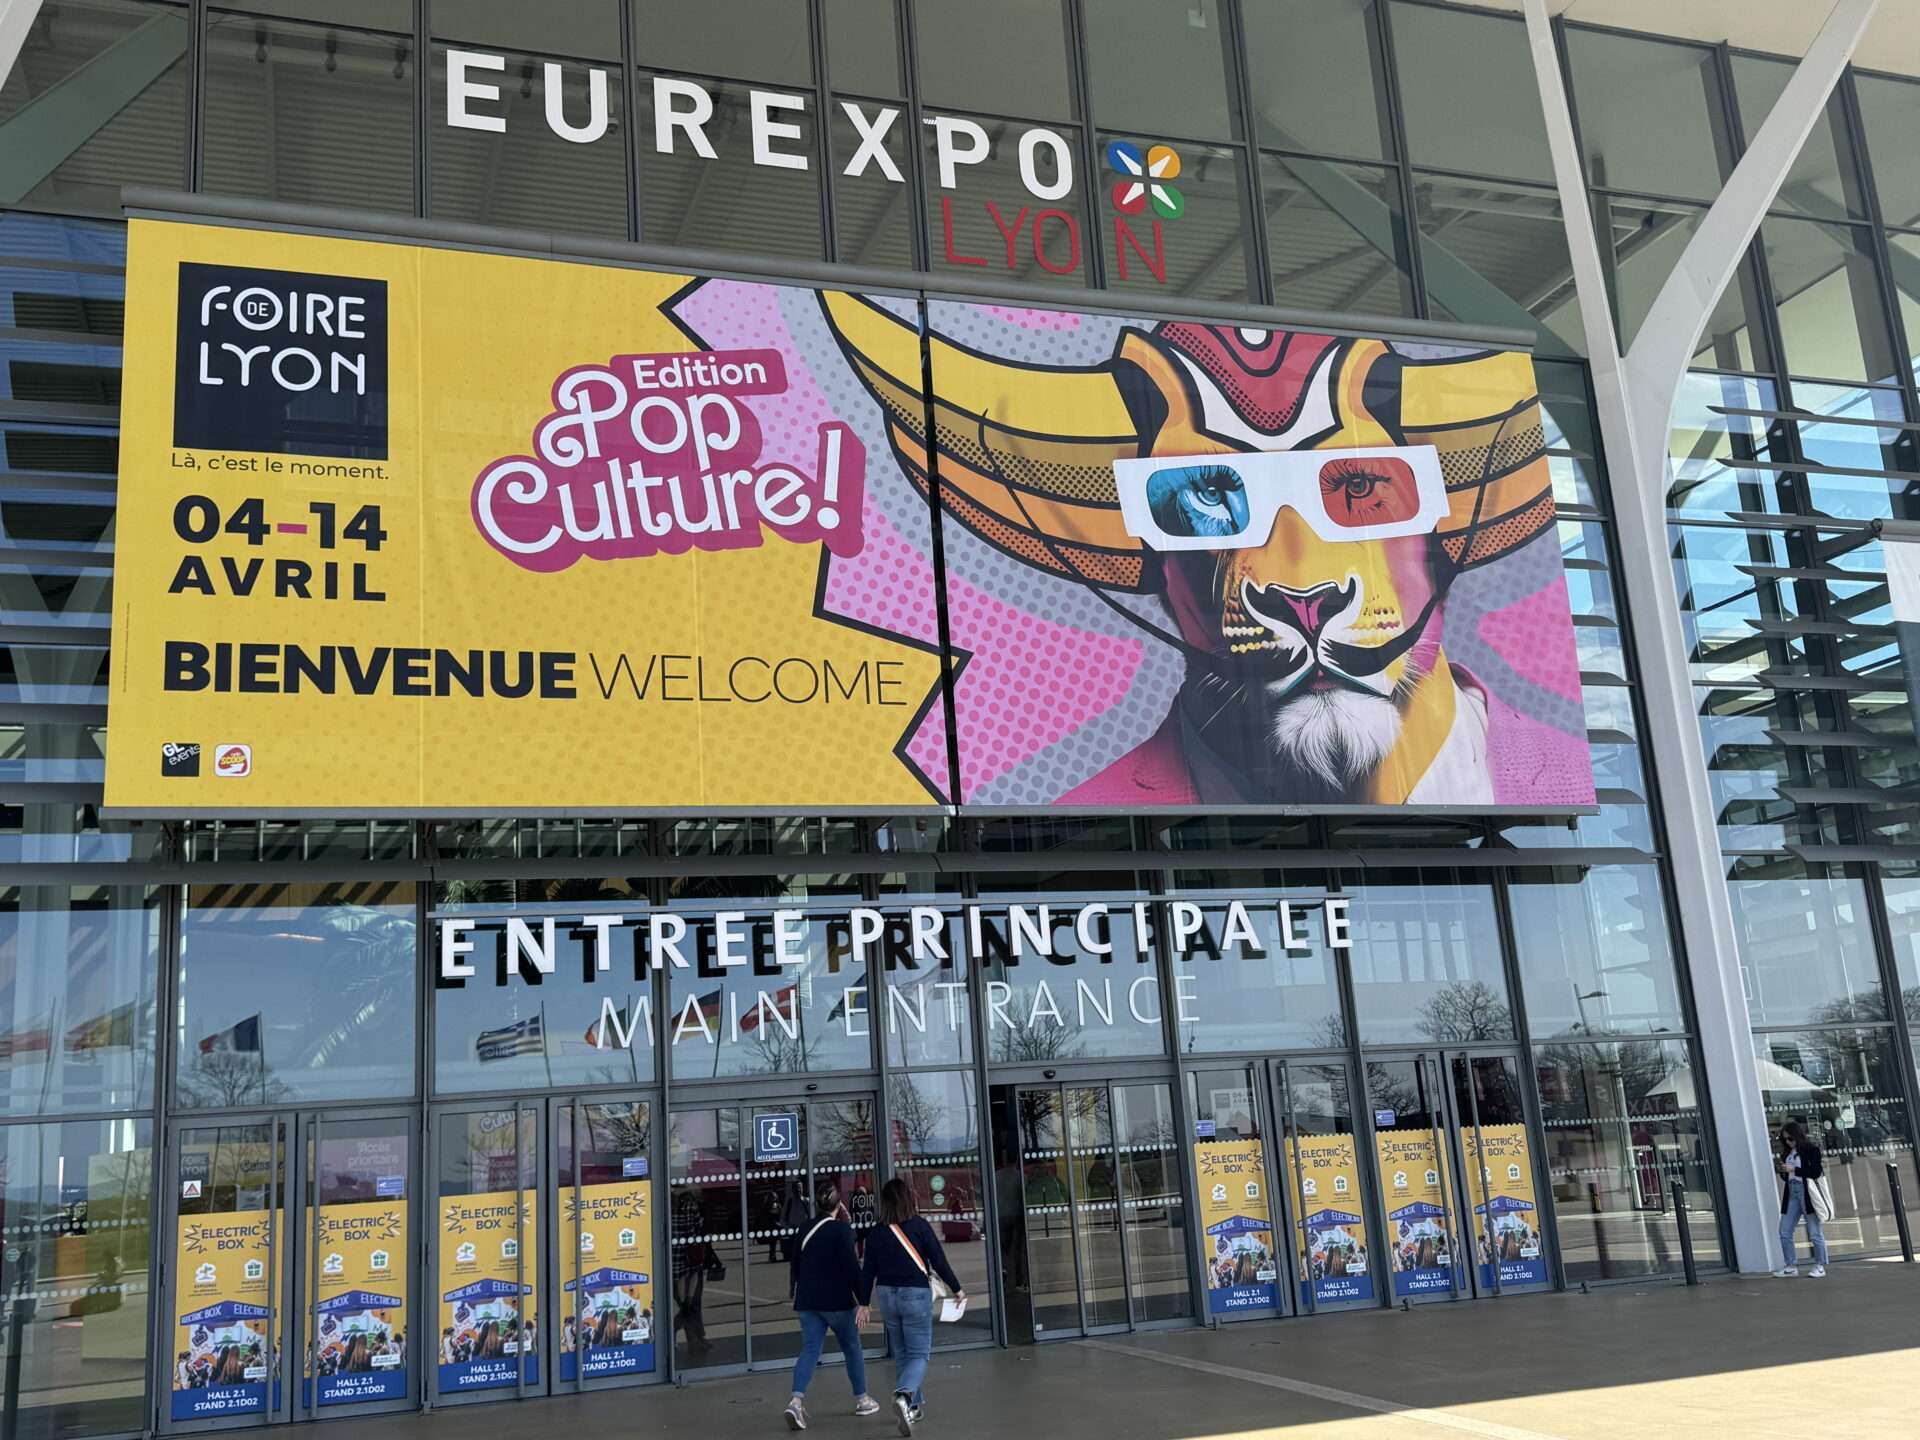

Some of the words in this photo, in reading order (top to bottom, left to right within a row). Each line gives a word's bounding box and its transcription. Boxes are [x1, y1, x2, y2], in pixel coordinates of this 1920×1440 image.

[445, 49, 1073, 200] EUREXPO
[942, 197, 1167, 283] LYON
[201, 285, 366, 340] FOIRE
[246, 301, 270, 318] DE
[199, 341, 366, 396] LYON
[632, 355, 768, 389] Edition
[540, 369, 741, 472] Pop
[171, 453, 201, 472] Là,
[208, 455, 258, 474] c'est
[265, 457, 284, 474] le
[290, 459, 389, 480] moment.
[478, 428, 843, 553] Culture!
[168, 555, 387, 602] AVRIL
[164, 640, 577, 699] BIENVENUE
[589, 652, 910, 705] WELCOME
[162, 742, 185, 757] GL
[168, 745, 200, 766] events
[440, 908, 805, 979] ENTREE
[850, 898, 1356, 963] PRINCIPALE
[597, 988, 799, 1050] MAIN
[844, 975, 1202, 1037] ENTRANCE
[1301, 1148, 1341, 1158] ELECTRIC
[1392, 1142, 1431, 1152] ELECTRIC
[1488, 1148, 1505, 1156] BOX
[1211, 1153, 1252, 1164] ELECTRIC
[1404, 1152, 1422, 1160] BOX
[1223, 1164, 1243, 1173] BOX
[1313, 1159, 1332, 1168] BOX
[580, 1196, 631, 1210] ELECTRIC
[461, 1205, 515, 1219] ELECTRIC
[594, 1209, 618, 1220] BOX
[328, 1216, 385, 1230] ELECTRIC
[476, 1219, 501, 1230] BOX
[201, 1225, 260, 1239] ELECTRIC
[344, 1230, 370, 1241] BOX
[217, 1239, 244, 1250] BOX
[1324, 1282, 1340, 1290] HALL
[1233, 1290, 1250, 1298] HALL
[1317, 1291, 1338, 1299] STAND
[1225, 1299, 1247, 1307] STAND
[591, 1352, 612, 1361] HALL
[613, 1351, 625, 1359] 2.1
[470, 1365, 493, 1373] HALL
[494, 1363, 506, 1372] 2.1
[336, 1378, 359, 1388] HALL
[360, 1377, 373, 1386] 2.1
[459, 1375, 488, 1384] STAND
[207, 1390, 231, 1400] HALL
[233, 1389, 246, 1398] 2.1
[324, 1388, 354, 1398] STAND
[356, 1385, 385, 1395] 2.1D02
[194, 1399, 226, 1411] STAND
[228, 1397, 258, 1408] 2.1D02
